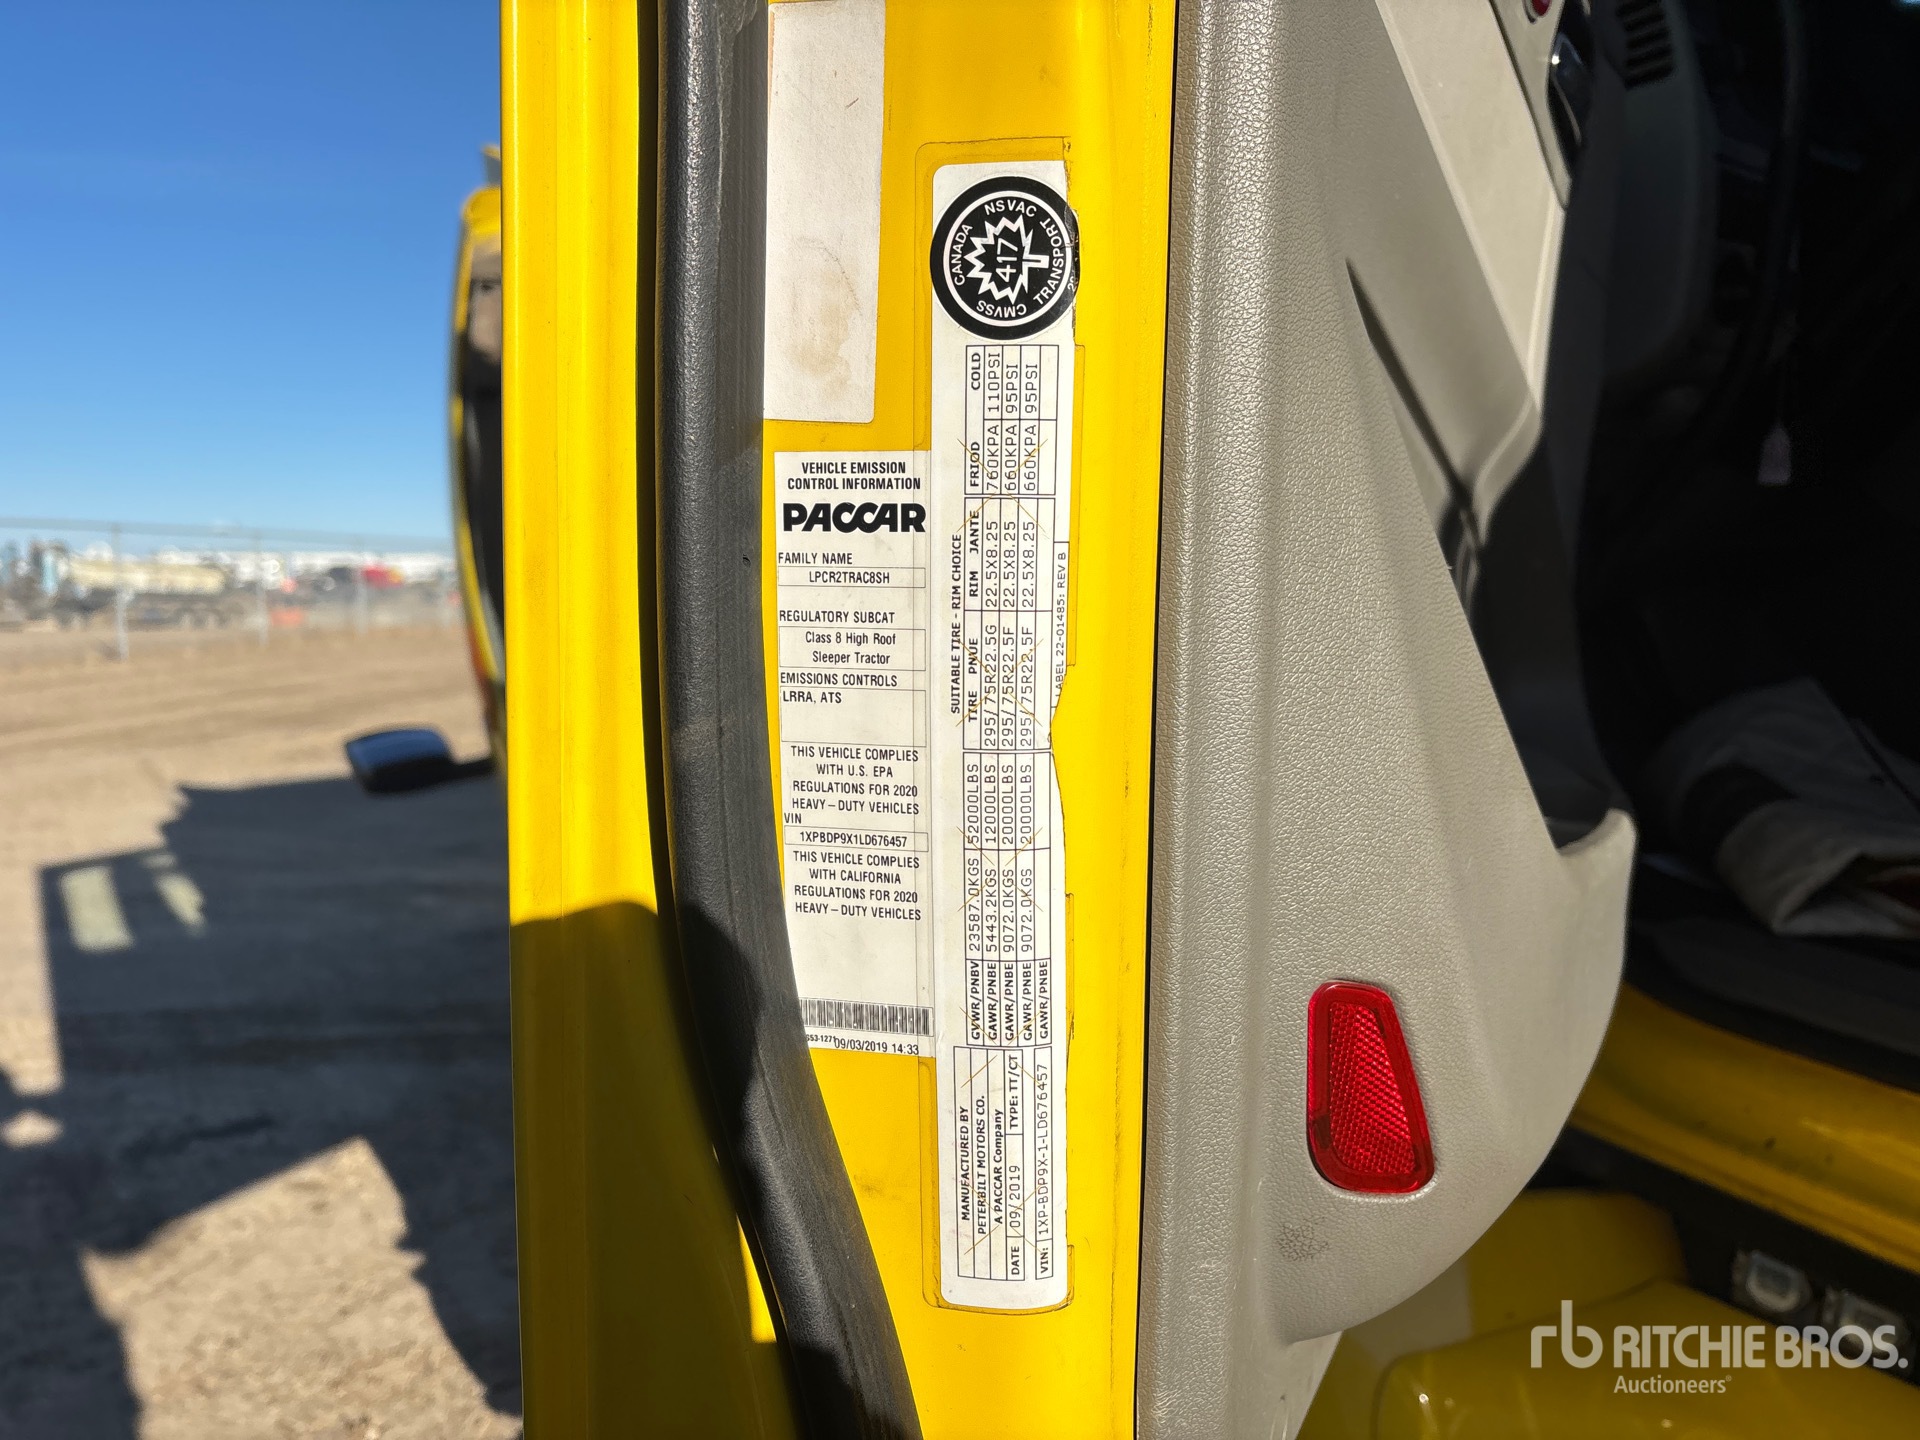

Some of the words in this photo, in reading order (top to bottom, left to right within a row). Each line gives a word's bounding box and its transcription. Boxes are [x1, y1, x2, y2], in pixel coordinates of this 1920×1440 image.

[984, 199, 1037, 217] NSVAC
[951, 224, 973, 285] CANADA
[996, 238, 1018, 282] 417
[1033, 218, 1064, 305] TRANSPORT
[976, 300, 1027, 318] CMVSS
[971, 352, 980, 390] COLD
[988, 353, 1000, 412] 110PSI
[1006, 364, 1018, 413] 95PSI
[1025, 364, 1037, 413] 95PSI
[802, 462, 847, 473] VEHICLE
[851, 462, 906, 473] EMISSION
[970, 442, 980, 487] FRIOD
[987, 425, 999, 490] 760KPA
[1005, 425, 1017, 491] 660KPA
[1024, 425, 1036, 491] 660KPA
[788, 478, 838, 489] CONTROL
[842, 478, 921, 489] INFORMATION
[783, 502, 926, 533] PACCAR
[970, 511, 979, 554] JANTE
[778, 552, 817, 564] FAMILY
[822, 553, 852, 564] NAME
[952, 534, 961, 581] CHOICE
[986, 521, 998, 607] 22.5X8.25
[1003, 521, 1016, 607] 22.5X8.25
[1022, 521, 1034, 607] 22.5X8.25
[1059, 552, 1066, 560] B
[809, 571, 890, 583] LPCR2TRAC8SH
[970, 571, 978, 597] RIM
[779, 610, 849, 622] REGULATORY
[853, 611, 895, 623] SUBCAT
[952, 586, 960, 609] RIM
[805, 631, 832, 643] Class
[836, 632, 842, 643] 8
[846, 632, 868, 646] High
[873, 633, 896, 644] Roof
[951, 622, 960, 651] TIRE
[1056, 594, 1065, 656] 22-01485:
[812, 651, 850, 664] Sleeper
[855, 652, 890, 664] Tractor
[969, 638, 978, 674] PNUE
[781, 673, 838, 685] EMISSIONS
[842, 674, 898, 687] CONTROLS
[783, 691, 816, 704] LRRA,
[820, 692, 842, 703] ATS
[951, 655, 960, 714] SUITABLE
[969, 691, 977, 722] TIRE
[791, 746, 815, 757] THIS
[818, 747, 861, 759] VEHICLE
[865, 748, 919, 761] COMPLIES
[816, 764, 843, 775] WITH
[848, 765, 868, 777] U.S.
[873, 766, 893, 778] EPA
[793, 781, 865, 794] REGULATIONS
[869, 784, 890, 795] FOR
[894, 785, 918, 797] 2020
[967, 764, 979, 844] 52000LBS
[984, 764, 996, 843] 12000LBS
[1002, 764, 1013, 844] 20000LBS
[1021, 764, 1032, 844] 20000LBS
[784, 813, 802, 824] VIN
[869, 802, 919, 815] VEHICLES
[800, 832, 907, 847] 1XPBDP9X1LD676457
[793, 851, 817, 862] THIS
[821, 852, 863, 865] VEHICLE
[867, 855, 920, 868] COMPLIES
[809, 868, 836, 880] WITH
[840, 870, 901, 884] CALIFORNIA
[794, 885, 865, 899] REGULATIONS
[870, 889, 890, 901] FOR
[894, 890, 918, 903] 2020
[968, 858, 980, 951] 23587.0KGS
[985, 869, 997, 952] 5443.2KGS
[1002, 869, 1014, 952] 9072.0KGS
[1021, 869, 1032, 952] 9072.0KGS
[871, 907, 921, 920] VEHICLES
[970, 961, 981, 1040] GVWR/PNBV
[987, 962, 997, 1040] GAWR/PNBE
[1005, 963, 1015, 1041] GAWR/PNBE
[1023, 962, 1033, 1041] GAWR/PNBE
[1039, 961, 1049, 1039] GAWR/PNBE
[835, 1038, 887, 1052] 09/03/2019
[892, 1043, 919, 1055] 14:33
[1009, 1055, 1020, 1092] TT/CT
[959, 1106, 968, 1122] BY
[976, 1095, 984, 1115] CO.
[1009, 1095, 1018, 1128] TYPE:
[976, 1119, 986, 1168] MOTORS
[993, 1109, 1003, 1162] Company
[1037, 1065, 1048, 1234] 1XP-BDP9X-1-LD676457
[960, 1126, 970, 1220] MANUFACTURED
[994, 1167, 1002, 1212] PACCAR
[977, 1171, 986, 1235] PETERBILT
[995, 1215, 1002, 1224] A
[1011, 1246, 1020, 1275] DATE
[1040, 1247, 1048, 1273] VIN:
